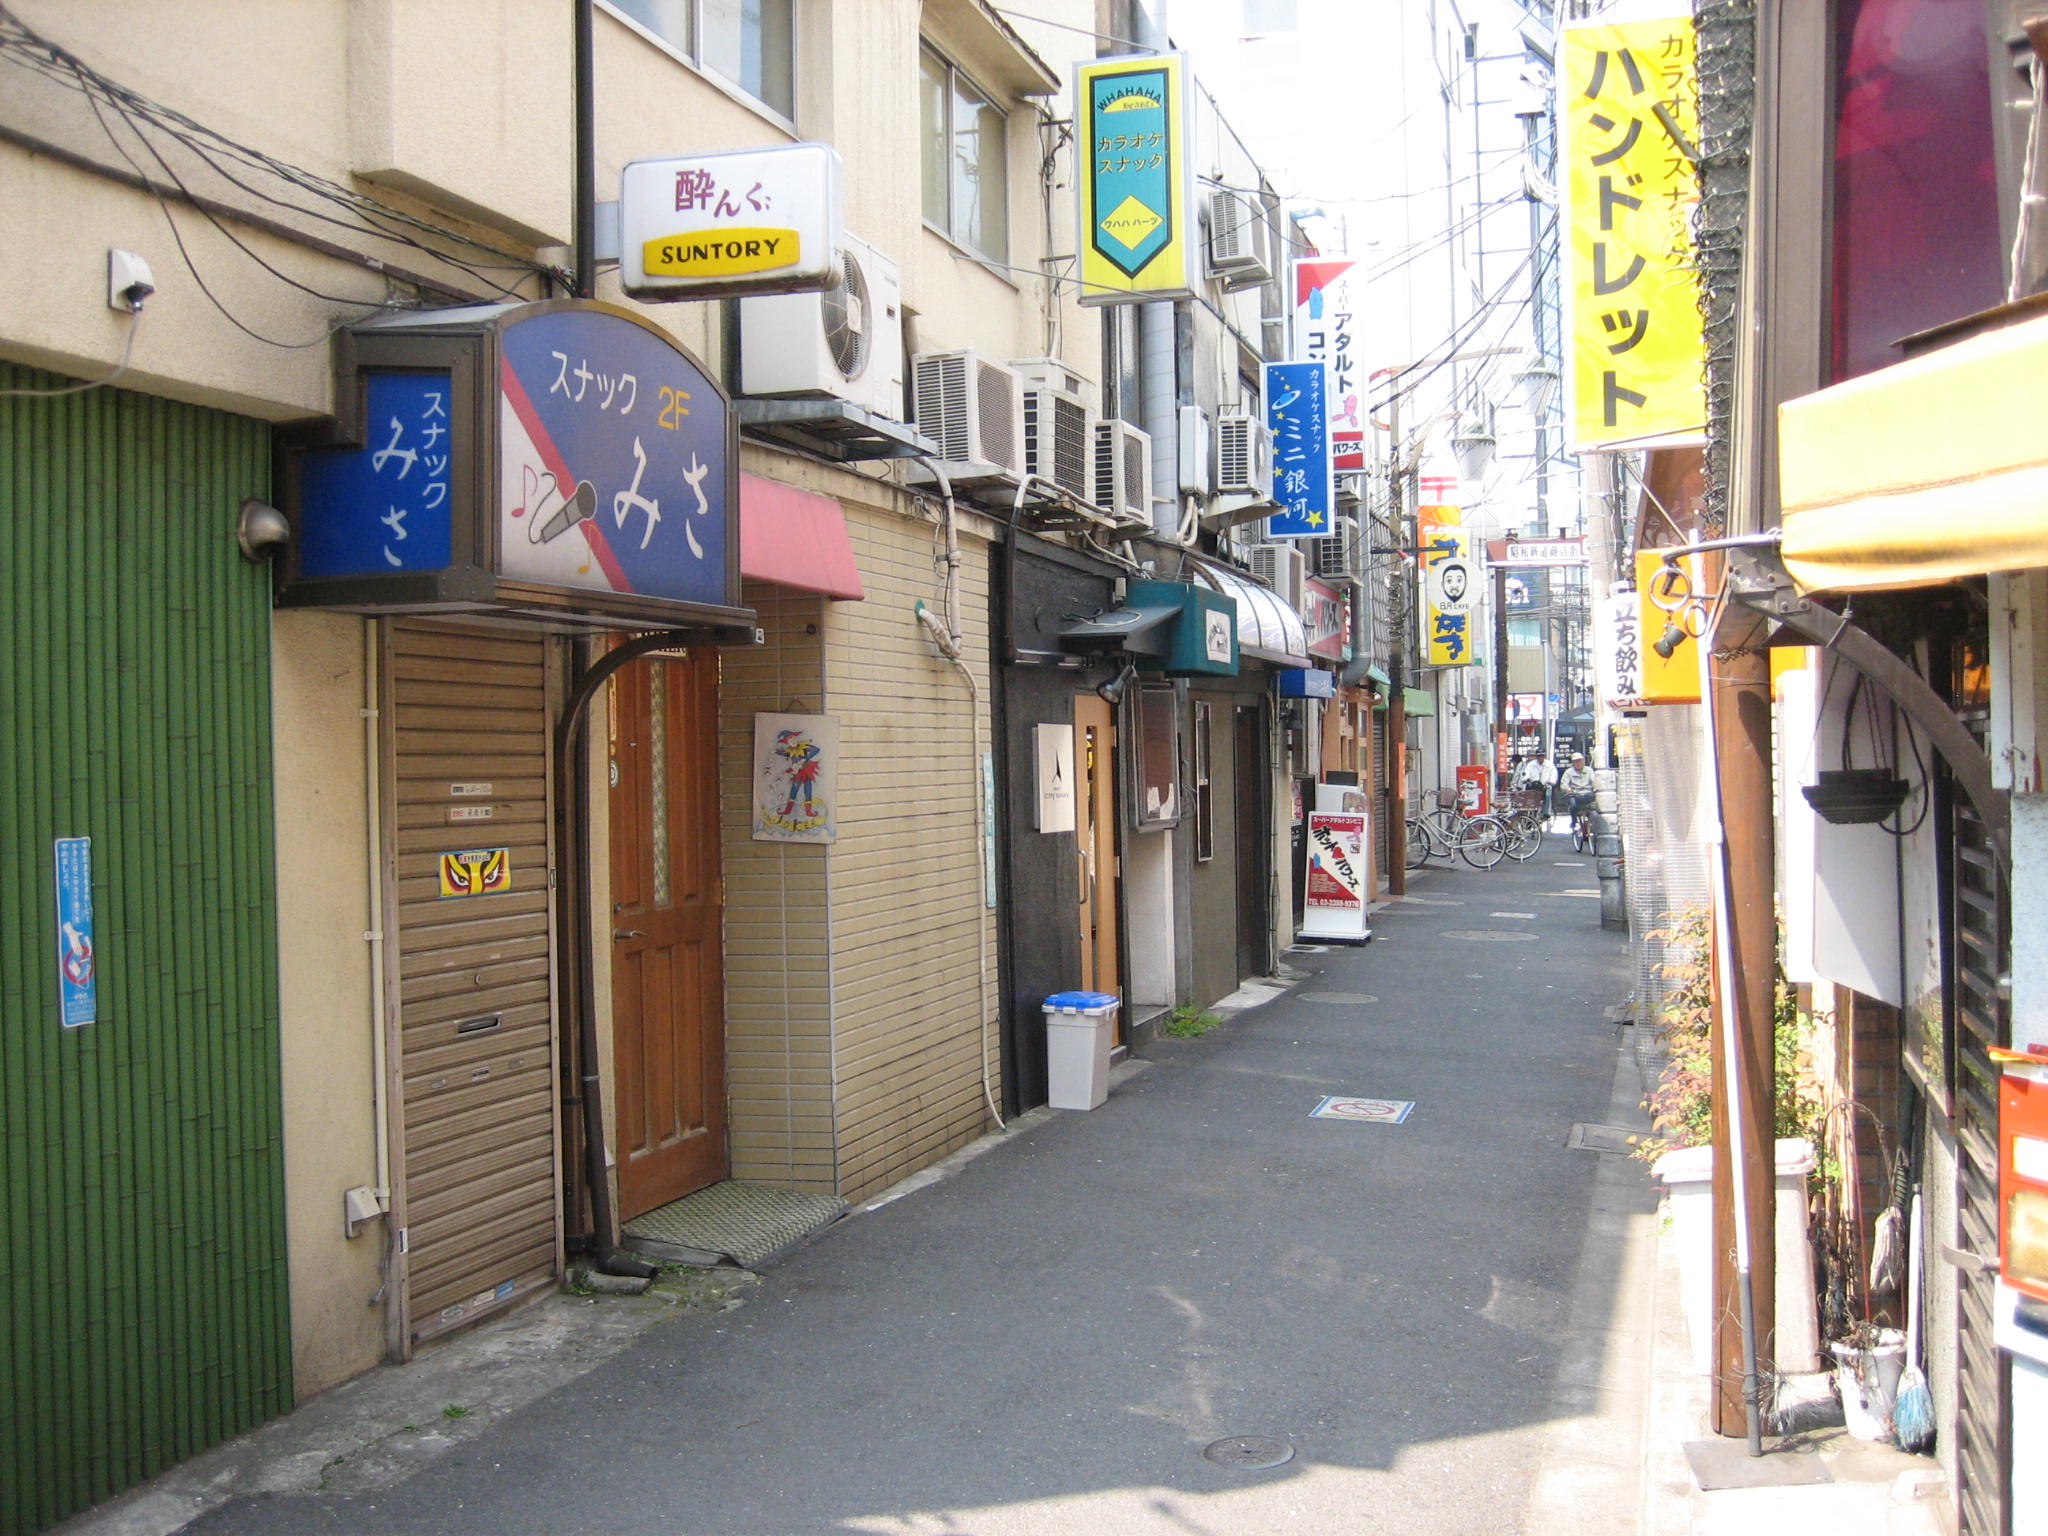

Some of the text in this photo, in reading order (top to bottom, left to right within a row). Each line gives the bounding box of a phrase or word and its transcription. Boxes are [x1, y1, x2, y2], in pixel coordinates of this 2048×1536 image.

[1097, 86, 1161, 113] WHAHAHA
[1098, 132, 1163, 153] カラオケ
[1098, 154, 1163, 174] スナック
[660, 238, 780, 264] SUNTORY
[1585, 47, 1648, 427] ハンドレット
[549, 350, 637, 415] スナック
[657, 385, 691, 431] 2F
[1308, 368, 1321, 454] カラオケスナック
[422, 392, 447, 509] スナック
[1283, 417, 1310, 522] ミニ銀河
[1333, 441, 1362, 455] パワーズ
[372, 416, 419, 566] みさ
[613, 436, 710, 559] みさ
[1613, 602, 1638, 696] 立ち飲み
[1312, 825, 1338, 852] ホット
[1335, 858, 1360, 888] パワーズ
[1308, 898, 1319, 906] TEL
